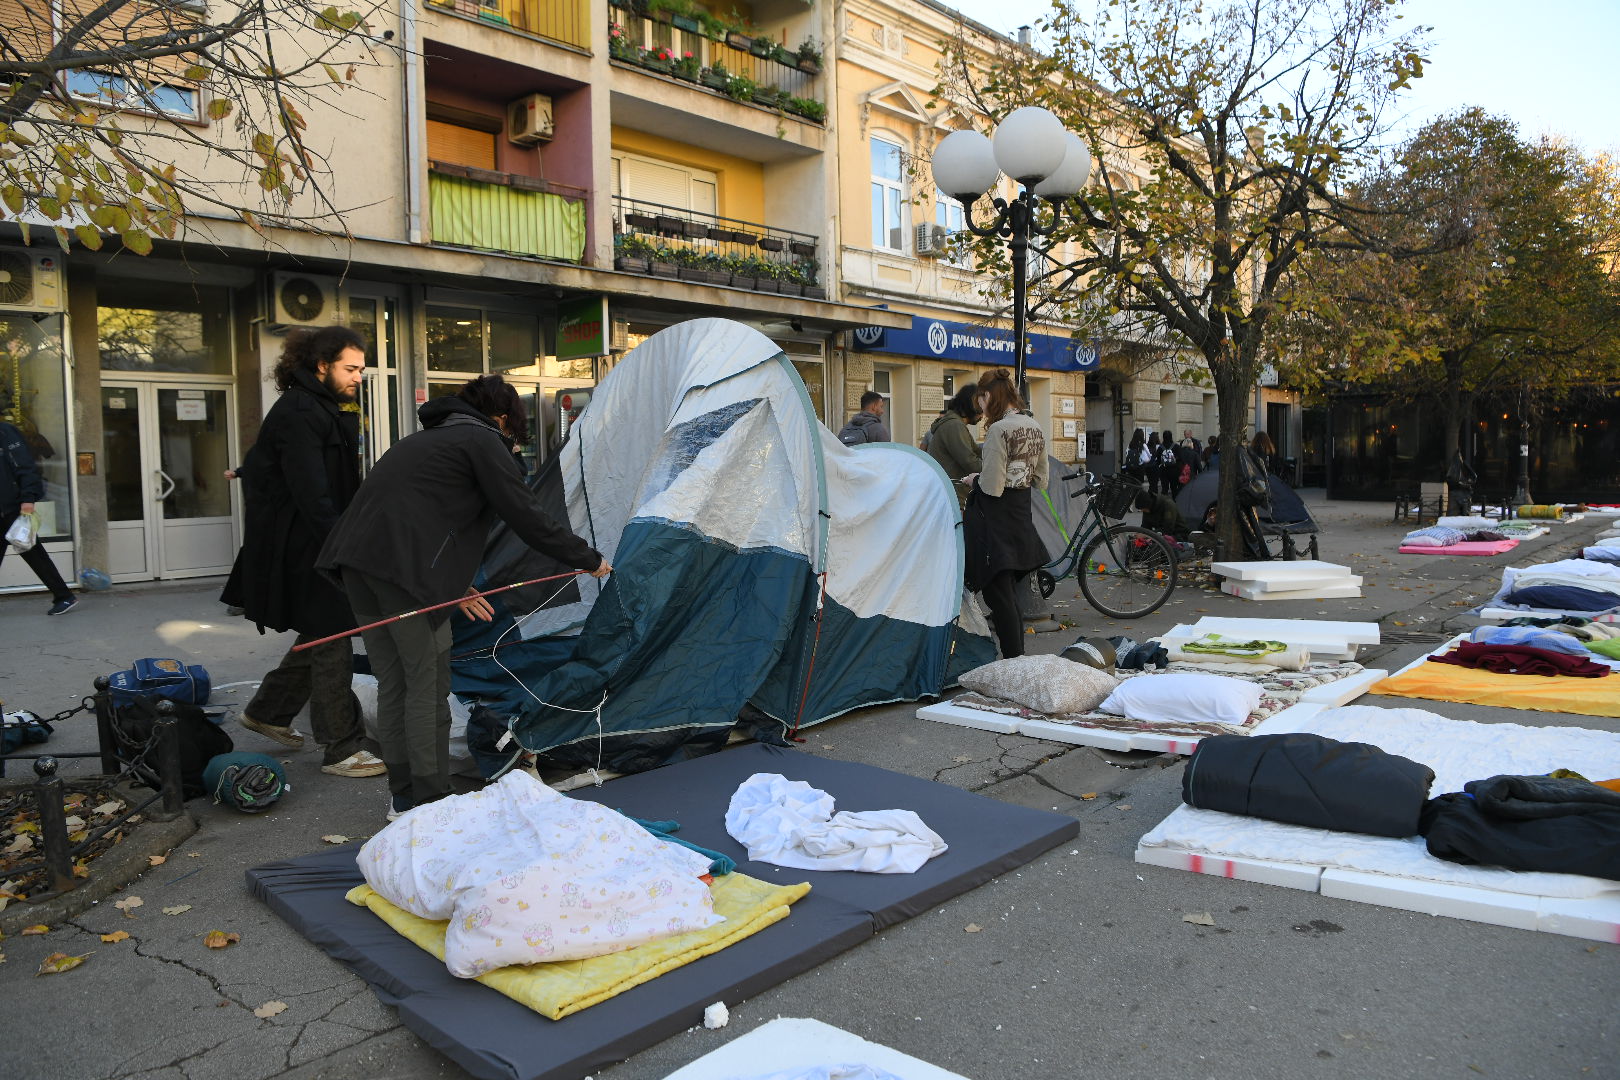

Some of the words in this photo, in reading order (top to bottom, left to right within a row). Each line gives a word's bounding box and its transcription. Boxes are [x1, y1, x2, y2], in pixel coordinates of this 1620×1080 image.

[563, 320, 601, 343] SHOP
[951, 333, 982, 349] ДУНАВ
[983, 338, 1033, 355] ОСИГУРЕ
